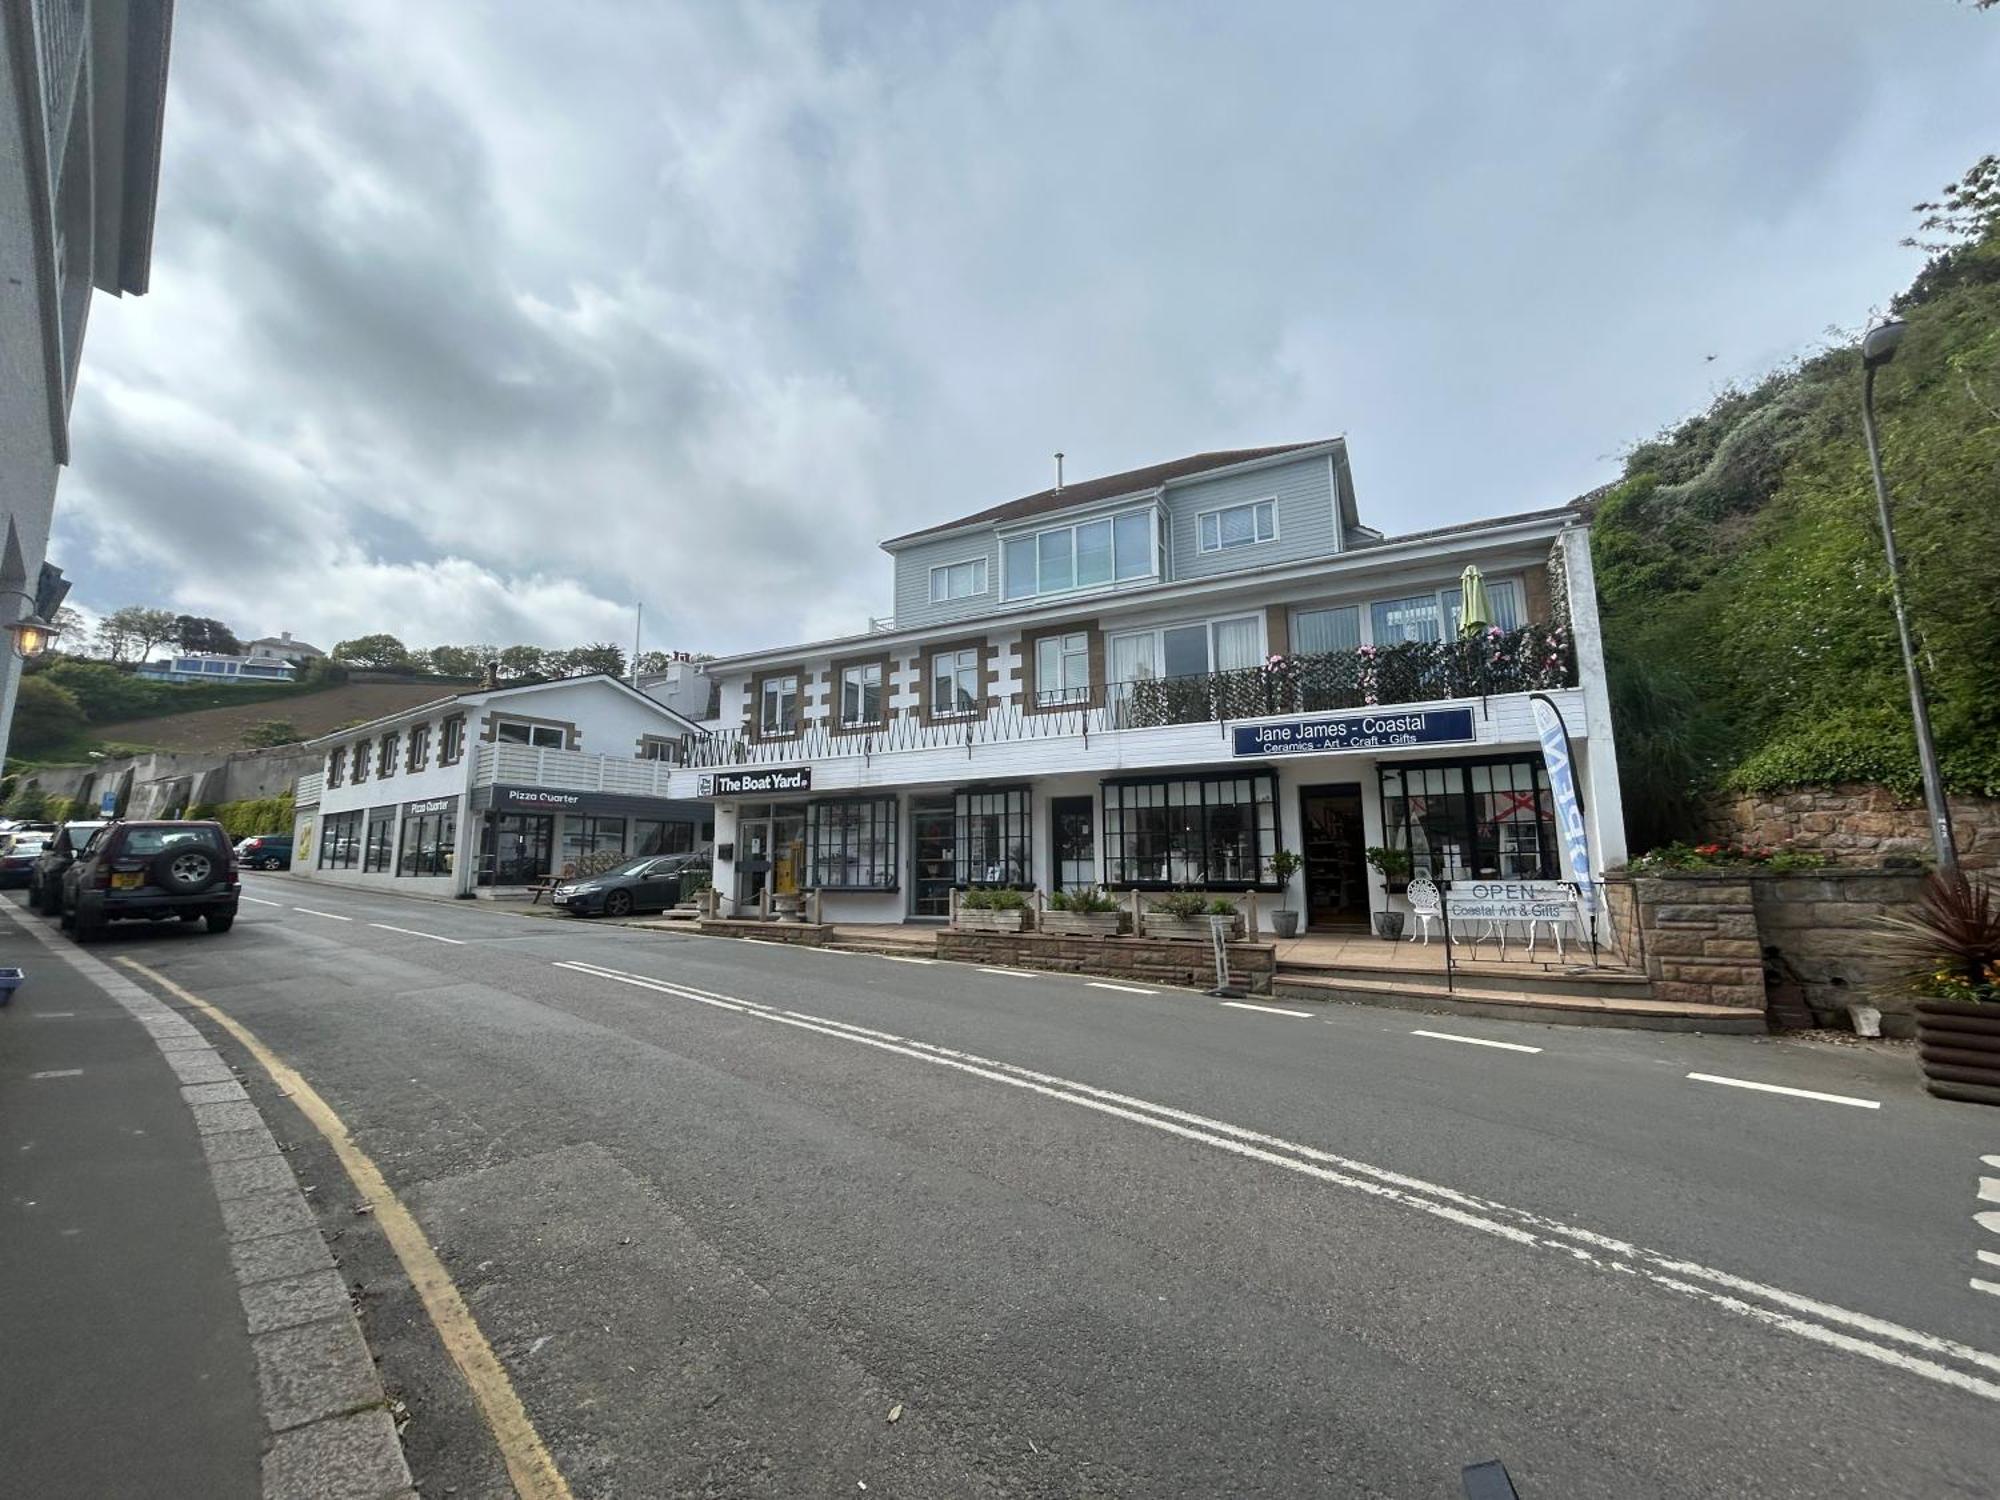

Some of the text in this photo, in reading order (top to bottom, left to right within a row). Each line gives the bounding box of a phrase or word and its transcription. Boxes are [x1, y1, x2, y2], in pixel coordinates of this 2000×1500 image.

[1256, 727, 1291, 742] Jane
[1296, 722, 1347, 738] James
[1362, 715, 1426, 733] Coastal
[1263, 740, 1314, 753] Ceramics
[1323, 738, 1340, 749] Art
[1350, 736, 1378, 747] Craft
[1389, 733, 1417, 744] Gifts
[720, 778, 741, 791] The
[742, 775, 770, 790] Boat
[772, 773, 801, 788] Yard
[509, 790, 537, 801] Pizza
[411, 803, 426, 814] Pizza
[1472, 884, 1535, 899] OPEN
[1452, 903, 1560, 917] Coastal Art & Gifts
